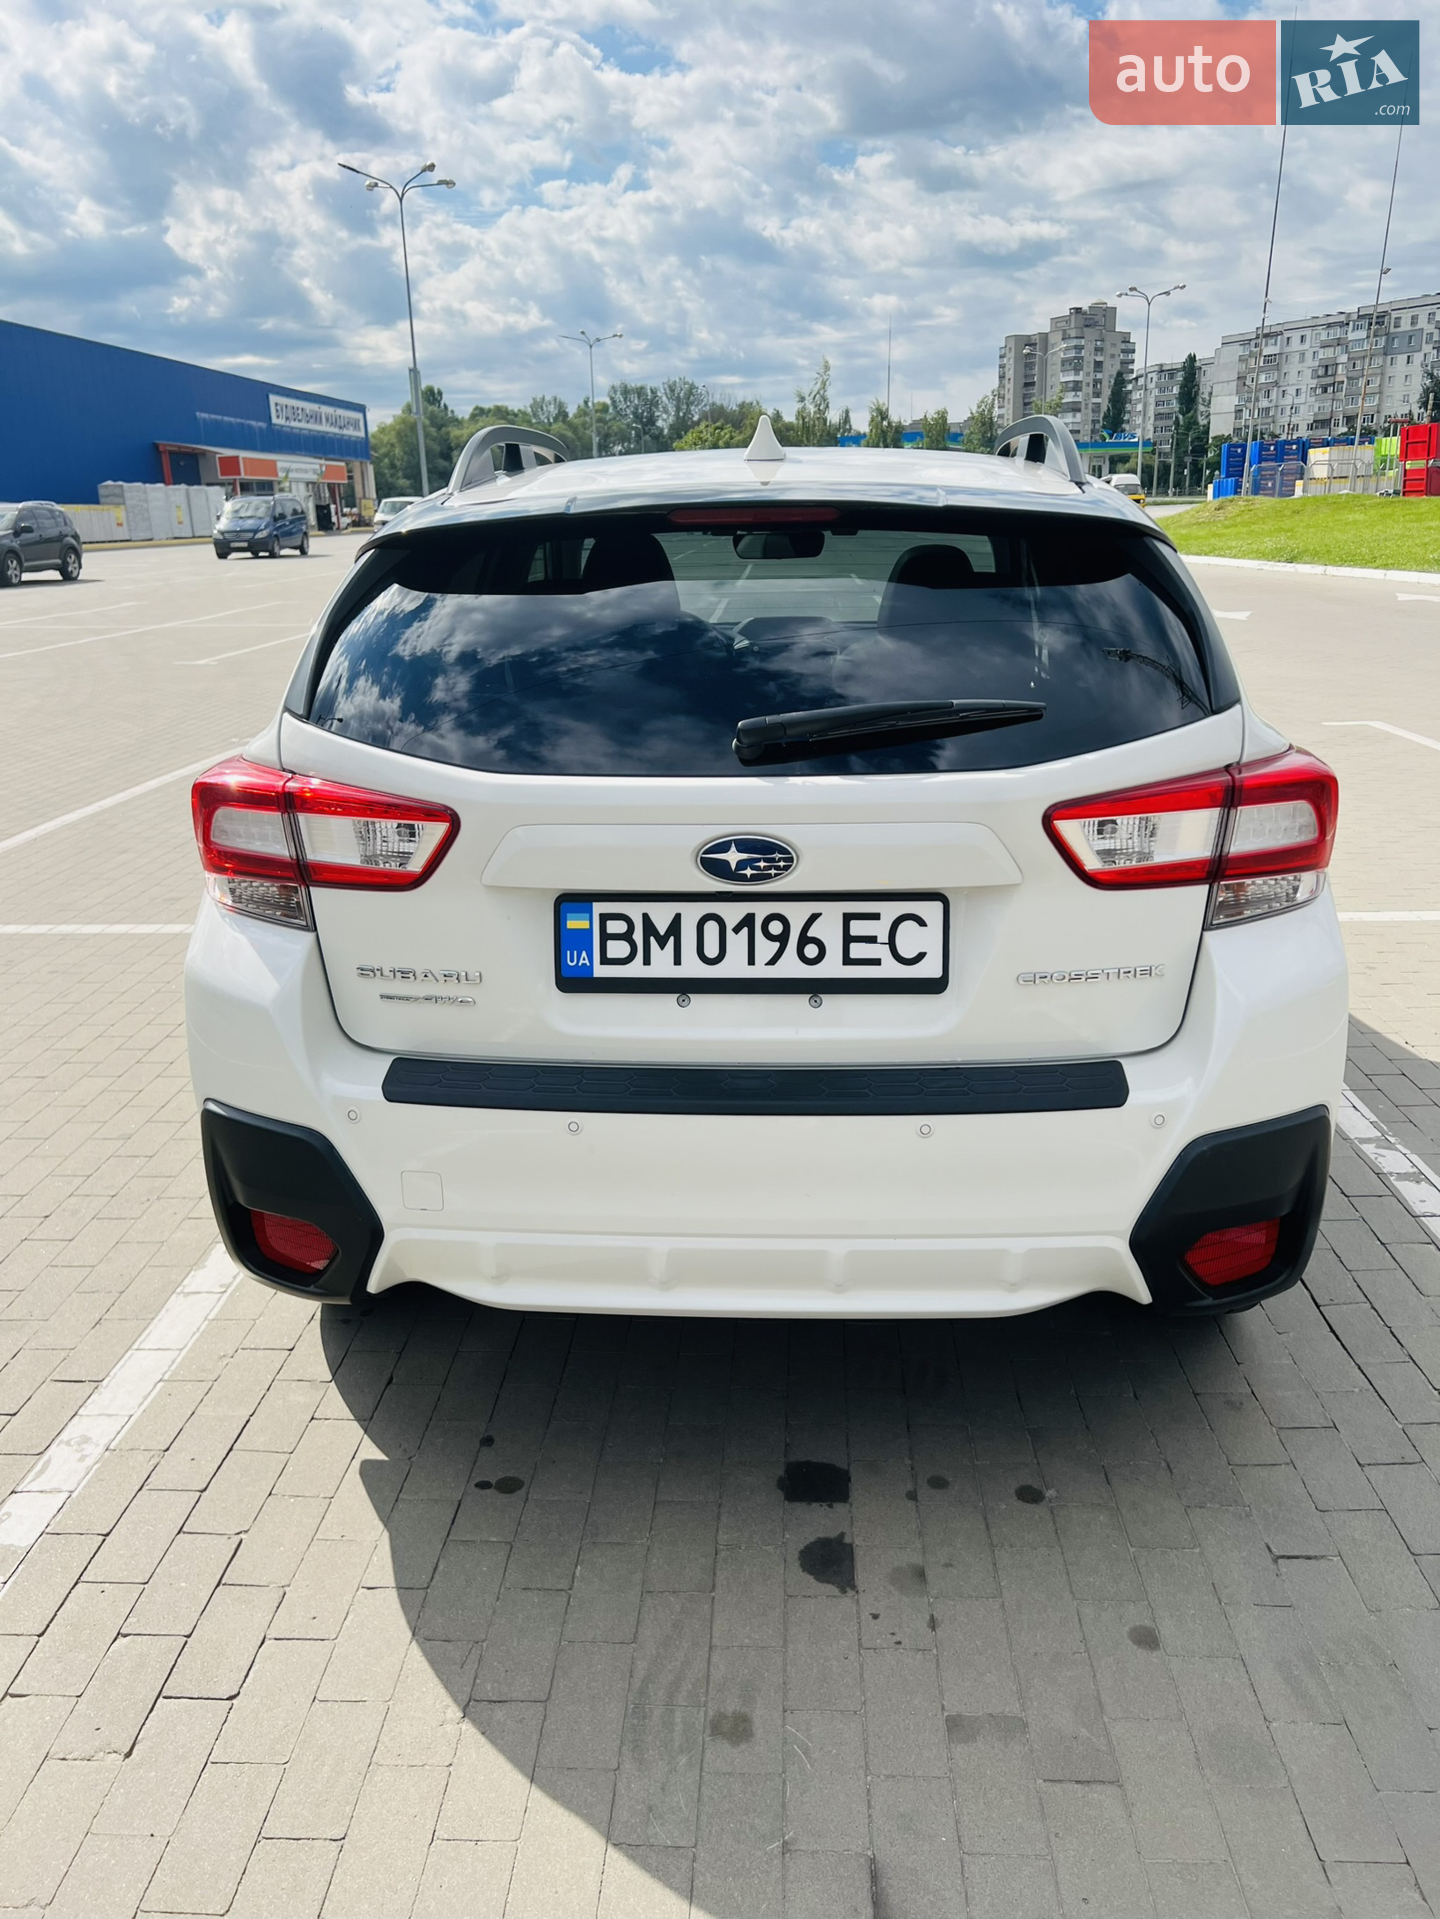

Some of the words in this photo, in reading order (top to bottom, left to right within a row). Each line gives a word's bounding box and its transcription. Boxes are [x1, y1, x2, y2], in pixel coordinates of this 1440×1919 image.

[274, 402, 323, 426] БУДІВЕЛЬНИЙ
[324, 409, 362, 432] МАЙДАНЧИК
[567, 950, 591, 967] UA
[598, 912, 682, 966] BM
[696, 912, 827, 966] 0196
[842, 912, 929, 966] EC
[356, 964, 483, 985] SUBARU
[1016, 964, 1166, 985] CROSSTREK
